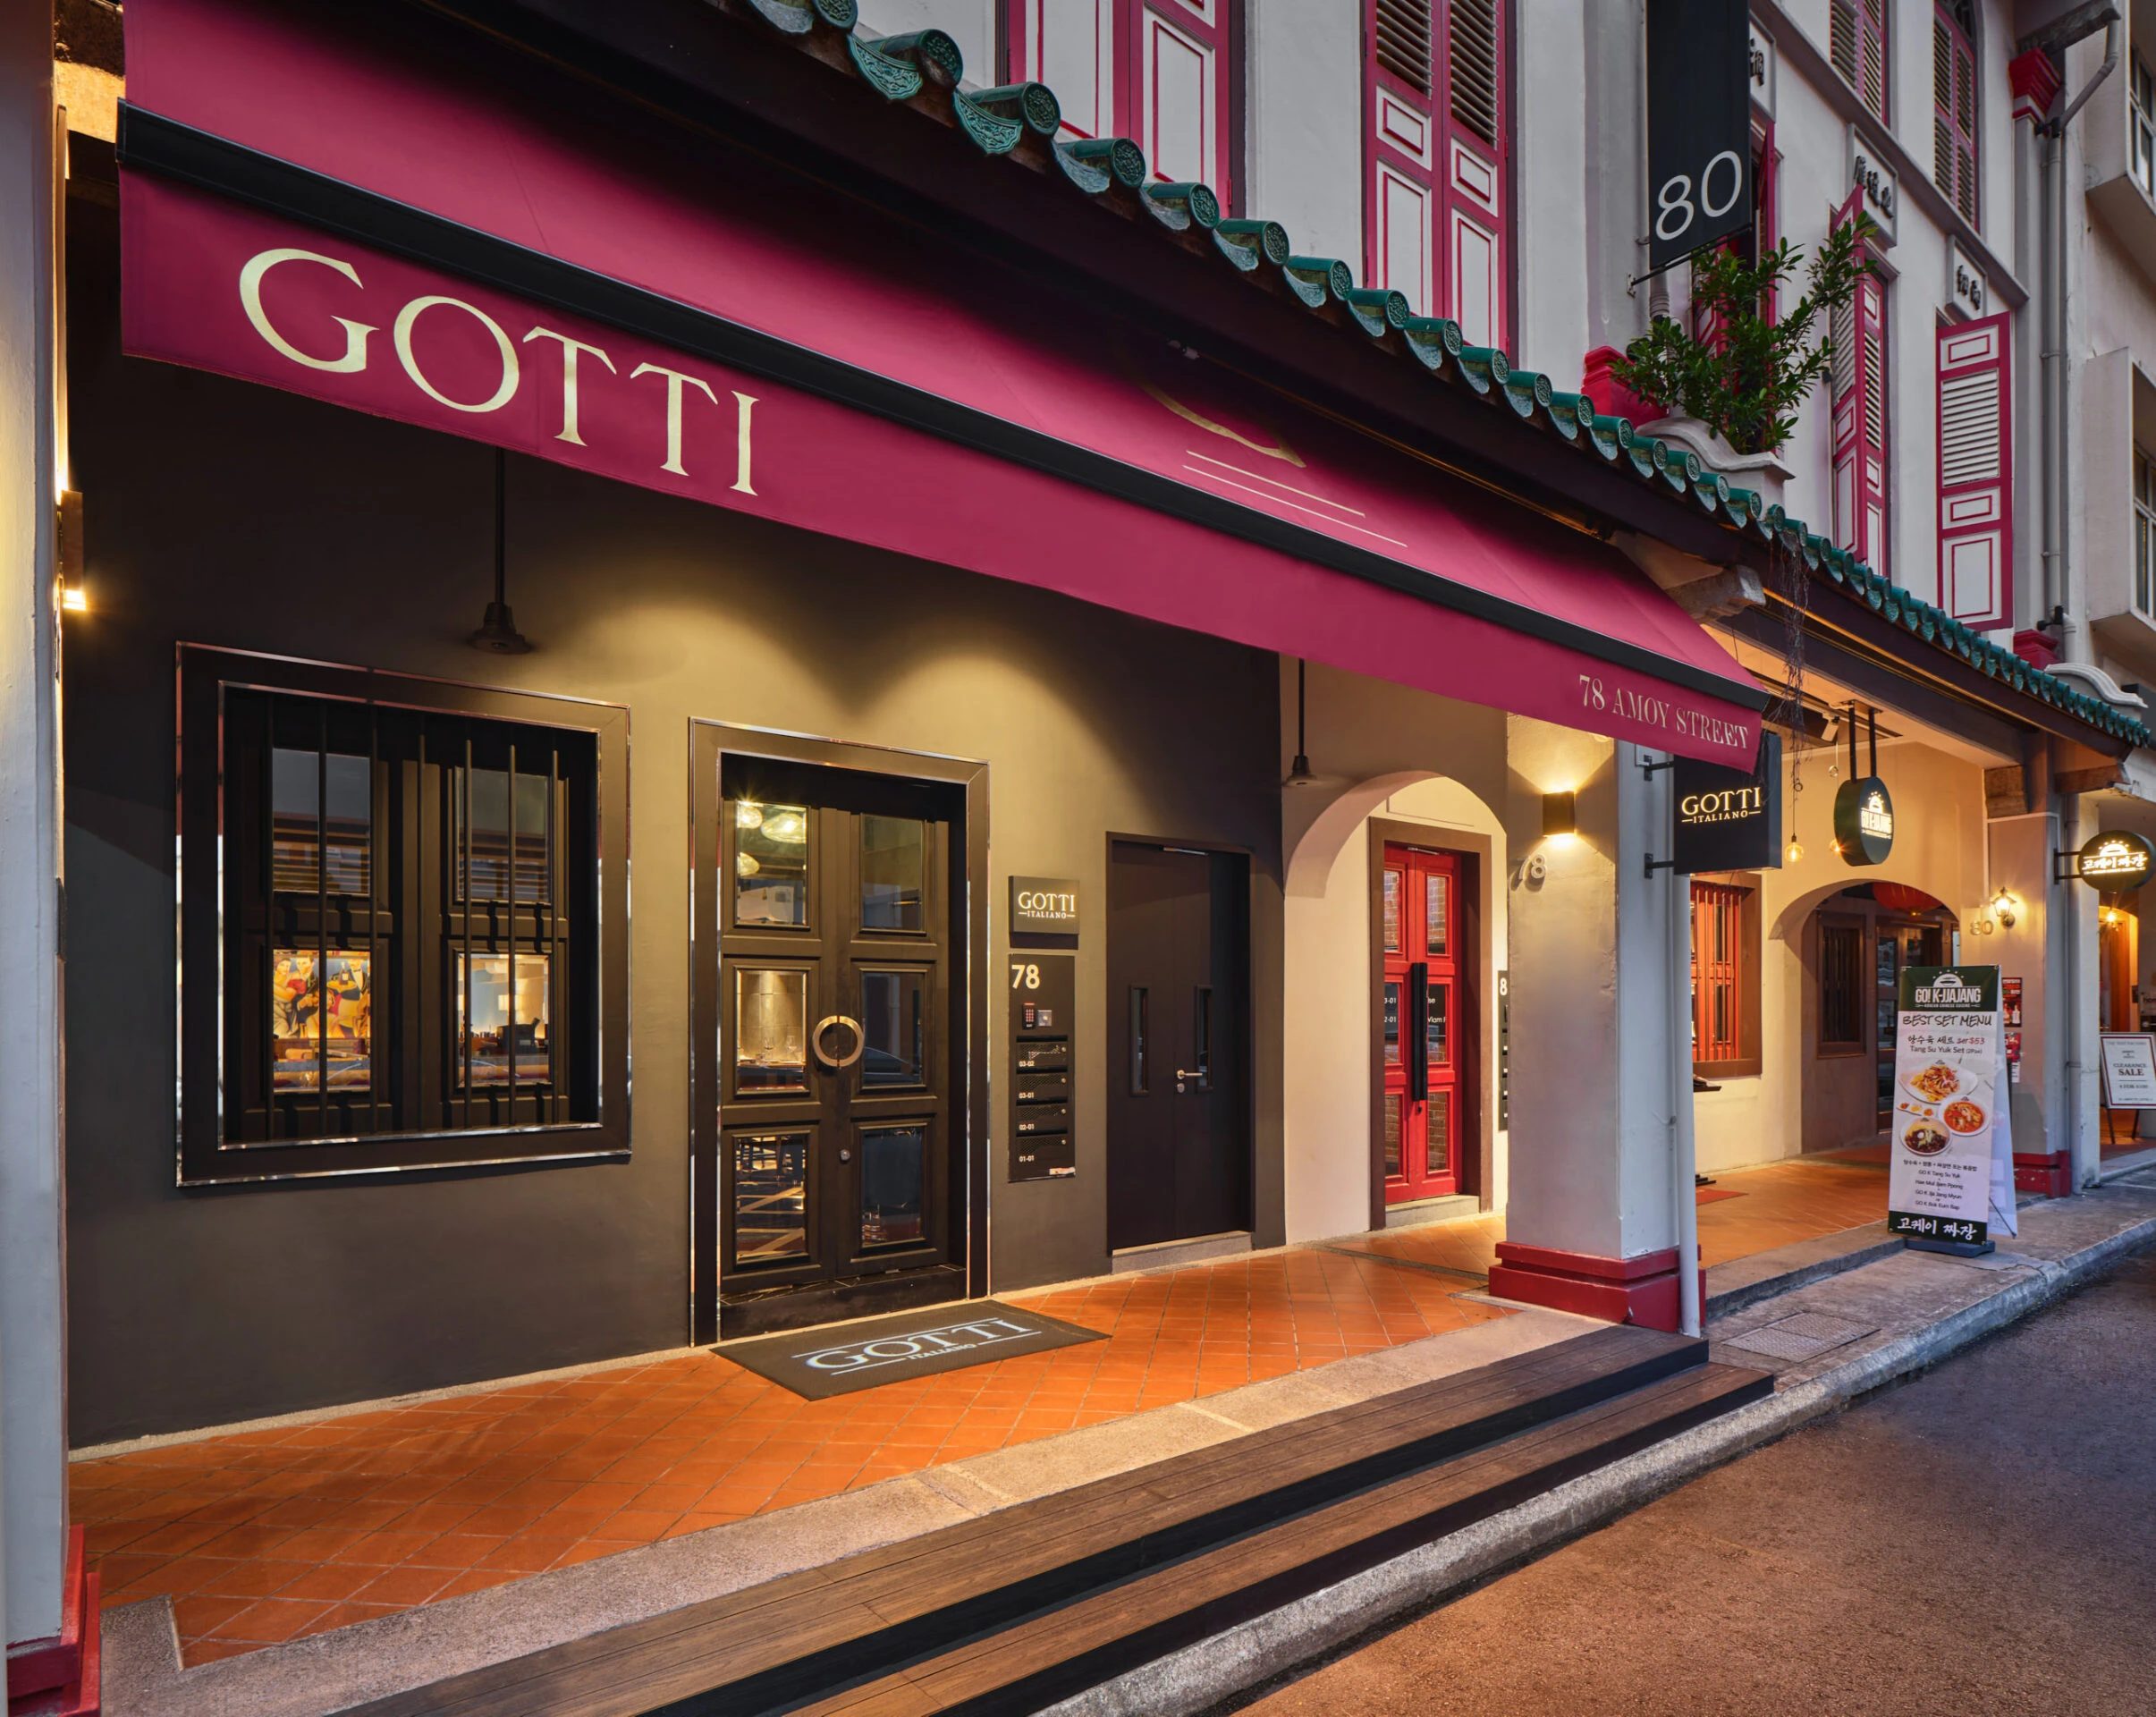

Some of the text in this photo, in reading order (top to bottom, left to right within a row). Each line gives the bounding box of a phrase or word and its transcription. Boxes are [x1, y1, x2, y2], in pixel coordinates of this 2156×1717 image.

[1656, 150, 1742, 241] 80
[240, 248, 759, 496] GOTTI
[1579, 674, 1748, 749] 78 AMOY STREET
[1681, 787, 1760, 816] GOTTI
[1693, 810, 1748, 824] ITALIANO
[1018, 892, 1076, 912] GOTTI
[1027, 910, 1067, 919] ITALIANO
[1970, 920, 1993, 935] 80
[1011, 964, 1041, 989] 78
[1915, 988, 1981, 1002] GO! K-JJAJANG
[1903, 1015, 1992, 1028] BEST SET MENU
[1910, 1045, 1925, 1053] Tang
[2118, 1068, 2144, 1076] SALE
[1897, 1217, 1937, 1234] 고케이
[1942, 1222, 1977, 1240] 짜장
[806, 1320, 1033, 1368] GOTTI
[906, 1343, 977, 1360] ITALIANO
